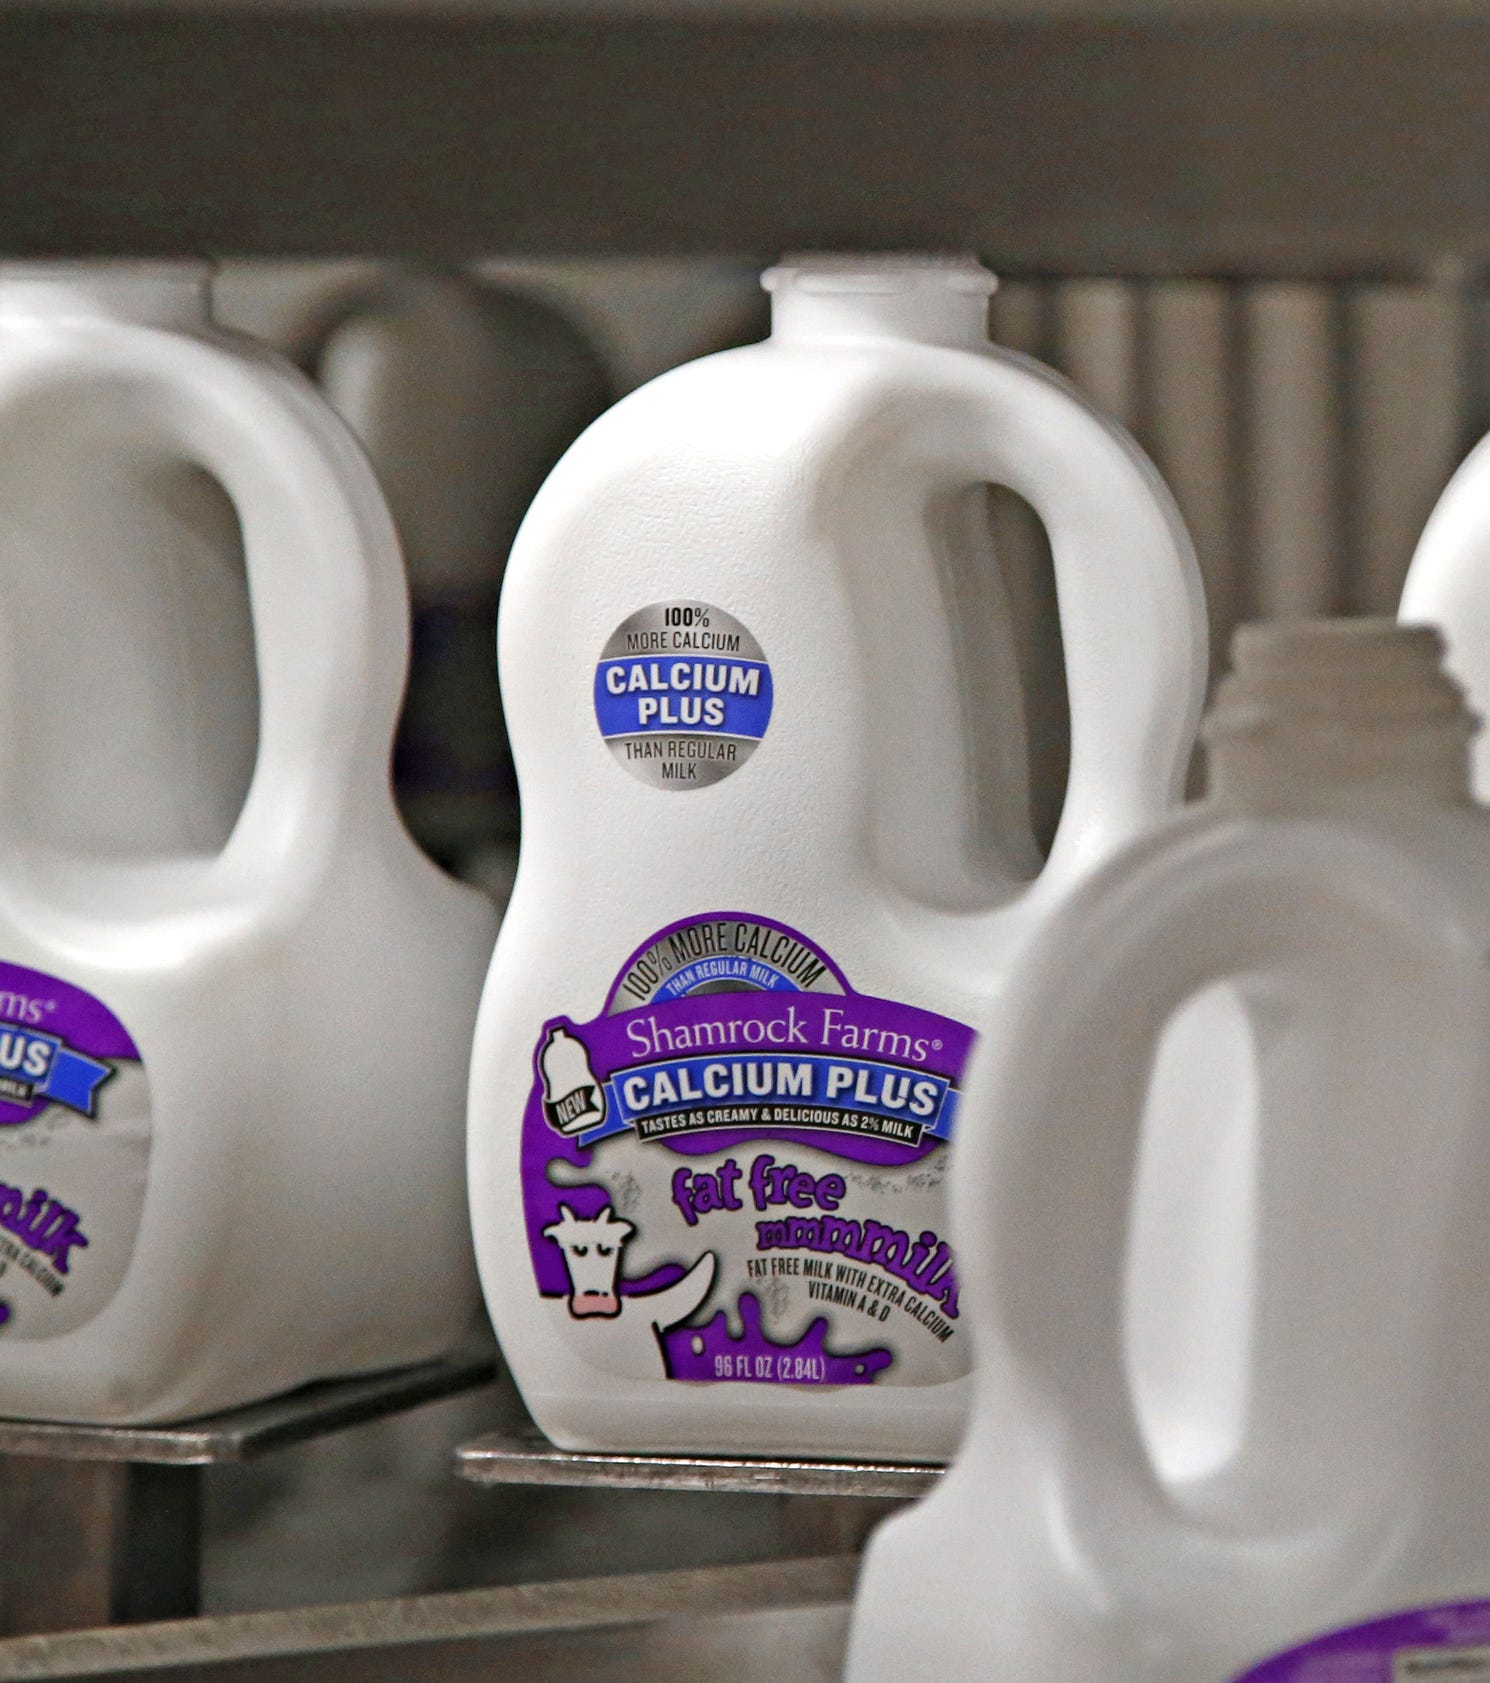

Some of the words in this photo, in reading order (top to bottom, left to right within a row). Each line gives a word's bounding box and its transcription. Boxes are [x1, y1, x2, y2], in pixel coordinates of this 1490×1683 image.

[664, 607, 710, 627] 100%
[627, 632, 667, 650] MORE
[673, 631, 740, 651] CALCIUM
[606, 662, 760, 695] CALCIUM
[638, 697, 724, 726] PLUS
[625, 741, 662, 760] THAN
[668, 741, 736, 760] REGULAR
[662, 762, 696, 779] MILK
[623, 946, 672, 1000] 100%
[669, 923, 728, 963] MORE
[735, 924, 826, 988] CALCIUM
[666, 969, 695, 996] THAN
[697, 960, 746, 978] REGULAR
[750, 965, 779, 988] MILK
[626, 1006, 809, 1058] Shamrock
[0, 1033, 51, 1076] US
[623, 1062, 812, 1111] CALCIUM
[826, 1065, 938, 1116] PLUS
[556, 1090, 587, 1125] NEW
[641, 1113, 686, 1134] TASTES
[688, 1111, 704, 1125] AS
[707, 1108, 758, 1124] CREAMY
[761, 1108, 771, 1121] &
[774, 1108, 839, 1125] DELICIOUS
[841, 1113, 858, 1127] AS
[860, 1116, 879, 1131] 2%
[881, 1120, 914, 1139] MILK
[672, 1158, 742, 1226] fat
[749, 1154, 847, 1211] free
[747, 1258, 767, 1278] FAT
[771, 1257, 800, 1276] FREE
[803, 1259, 833, 1280] MILK
[835, 1265, 867, 1288] WITH
[867, 1276, 905, 1307] EXTRA
[904, 1296, 954, 1343] CALCIUM
[808, 1281, 856, 1308] VITAMIN
[856, 1299, 866, 1314] A
[879, 1305, 891, 1322] D
[714, 1355, 733, 1378] 96
[736, 1355, 752, 1378] FL
[755, 1356, 773, 1378] OZ
[777, 1356, 826, 1382] (2.84L)
